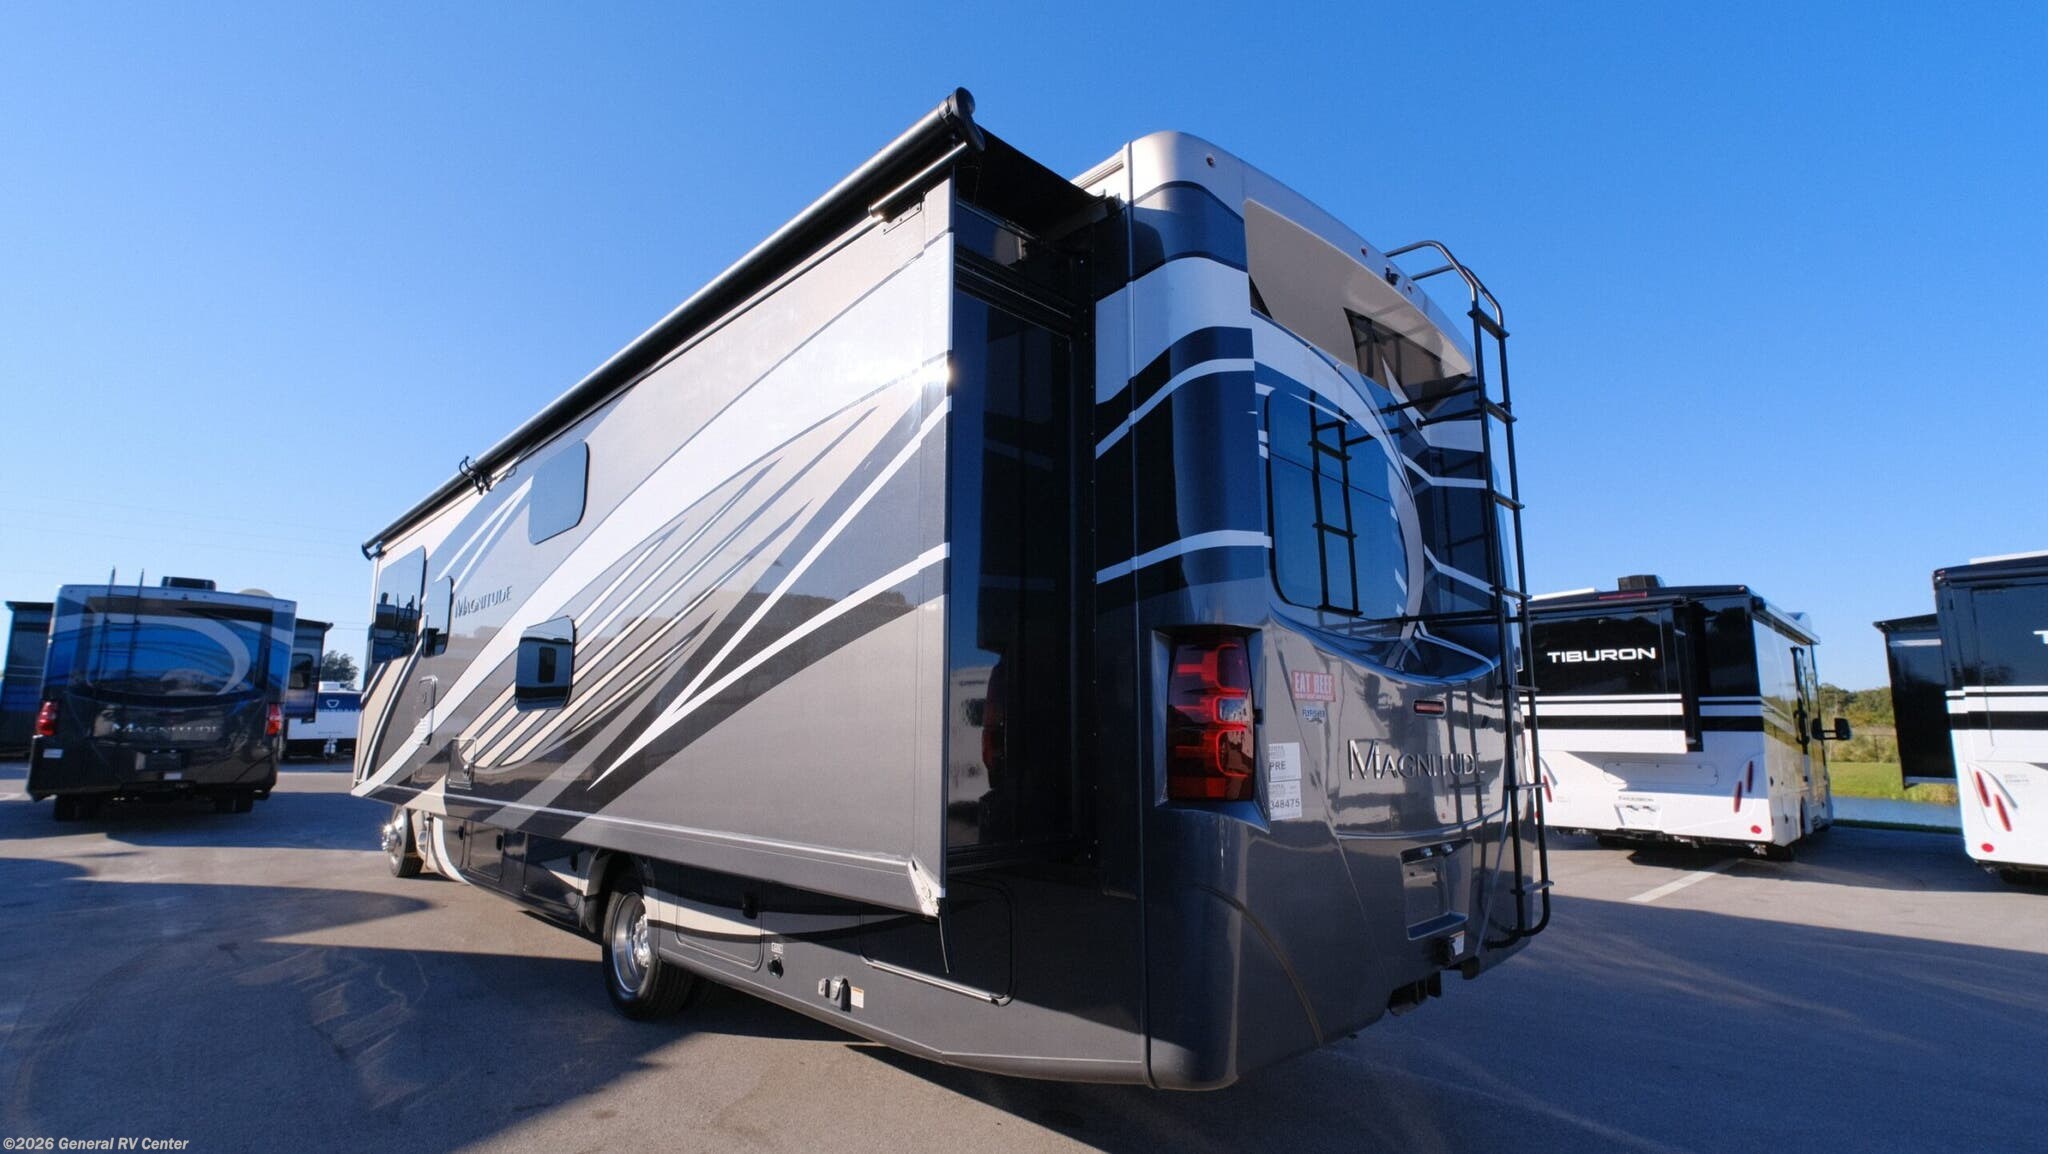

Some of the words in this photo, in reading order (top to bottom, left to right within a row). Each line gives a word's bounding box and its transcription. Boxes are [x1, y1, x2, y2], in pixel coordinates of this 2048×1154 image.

[454, 585, 512, 619] MAGNITUDE
[1547, 647, 1656, 663] TIBURON
[1269, 761, 1287, 770] PRE
[1348, 739, 1486, 779] MAGNITUDE
